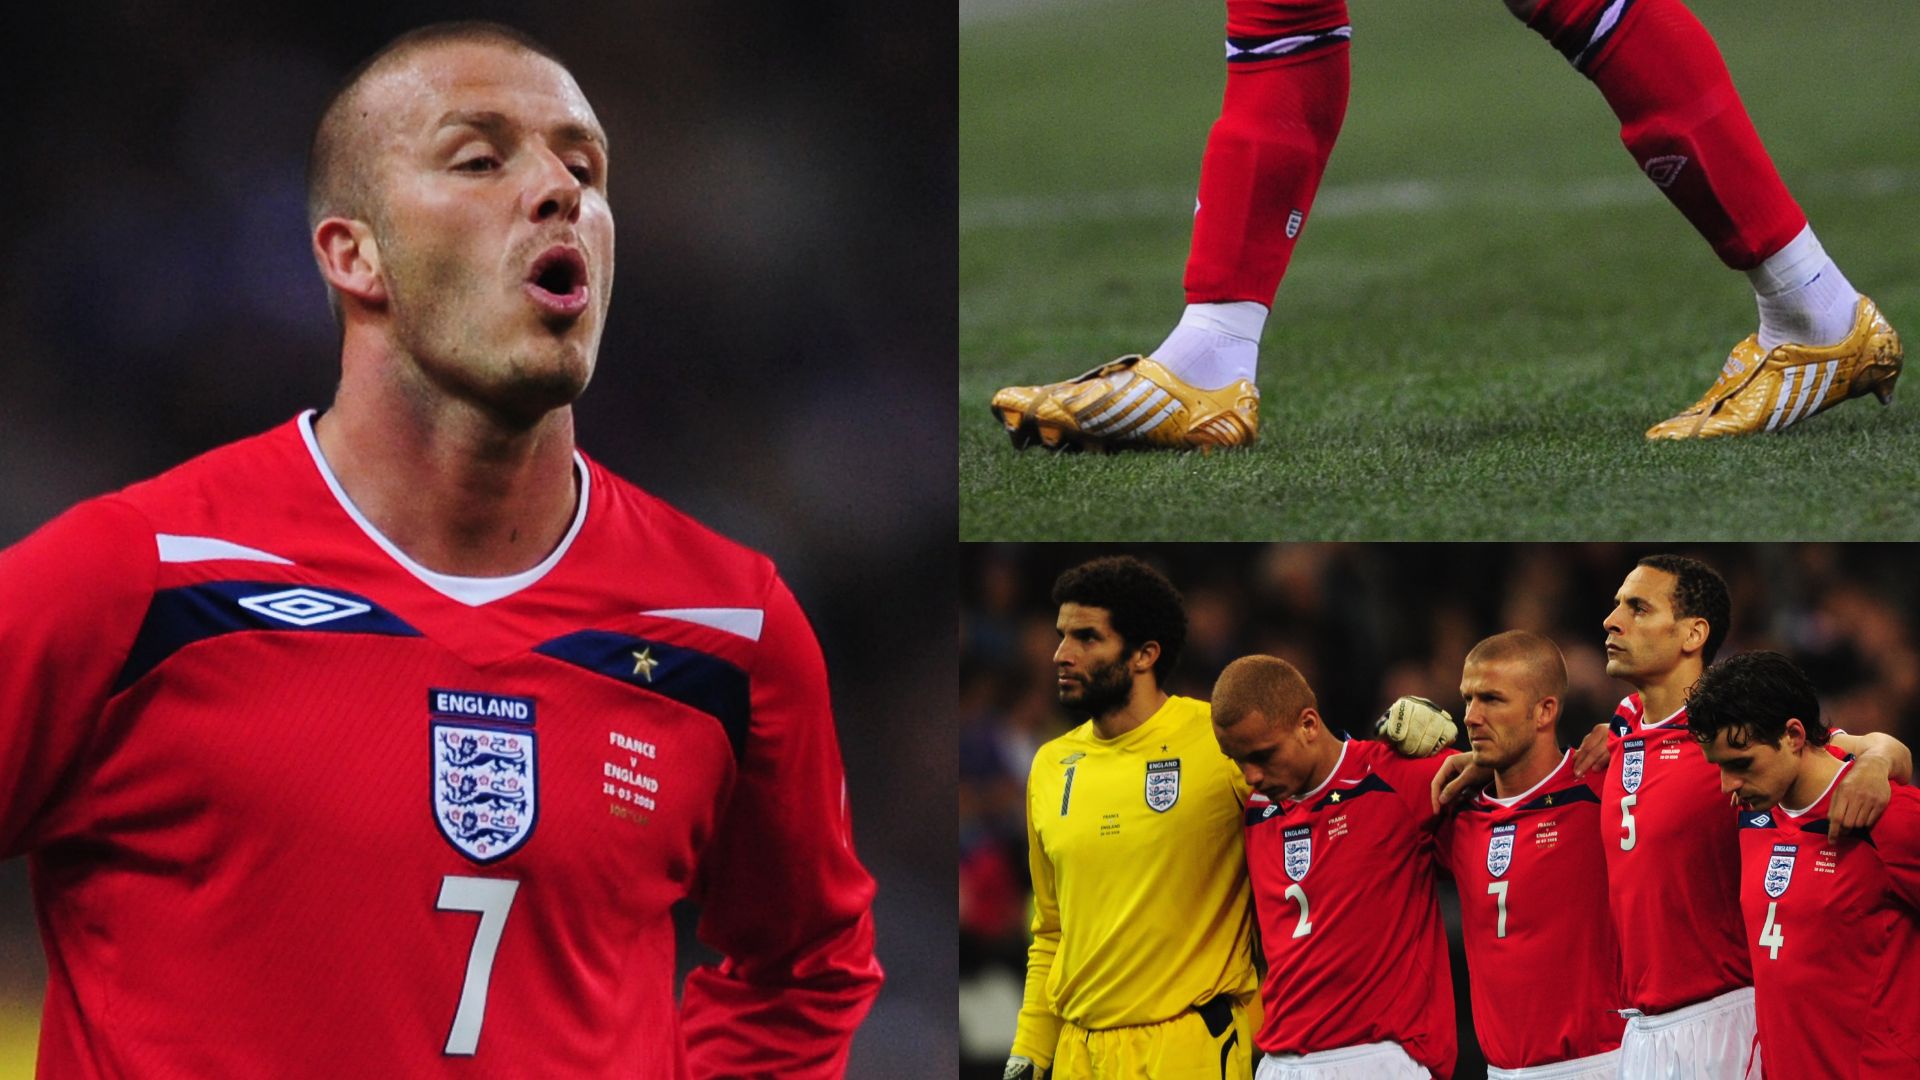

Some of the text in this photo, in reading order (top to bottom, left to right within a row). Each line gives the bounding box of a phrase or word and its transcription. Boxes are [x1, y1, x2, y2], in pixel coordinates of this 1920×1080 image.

[437, 693, 528, 719] ENGLAND
[609, 731, 656, 759] FRANCE
[1624, 740, 1644, 748] ENGLAND
[604, 762, 658, 793] ENGLAND
[1149, 761, 1178, 769] ENGLAND
[1061, 767, 1076, 816] 1
[1284, 828, 1310, 838] ENGLAND
[1493, 824, 1516, 834] ENGLAND
[1620, 794, 1637, 851] 5
[1285, 883, 1312, 939] 2
[1487, 881, 1509, 938] 7
[1759, 902, 1784, 960] 4
[437, 875, 520, 1056] 7
